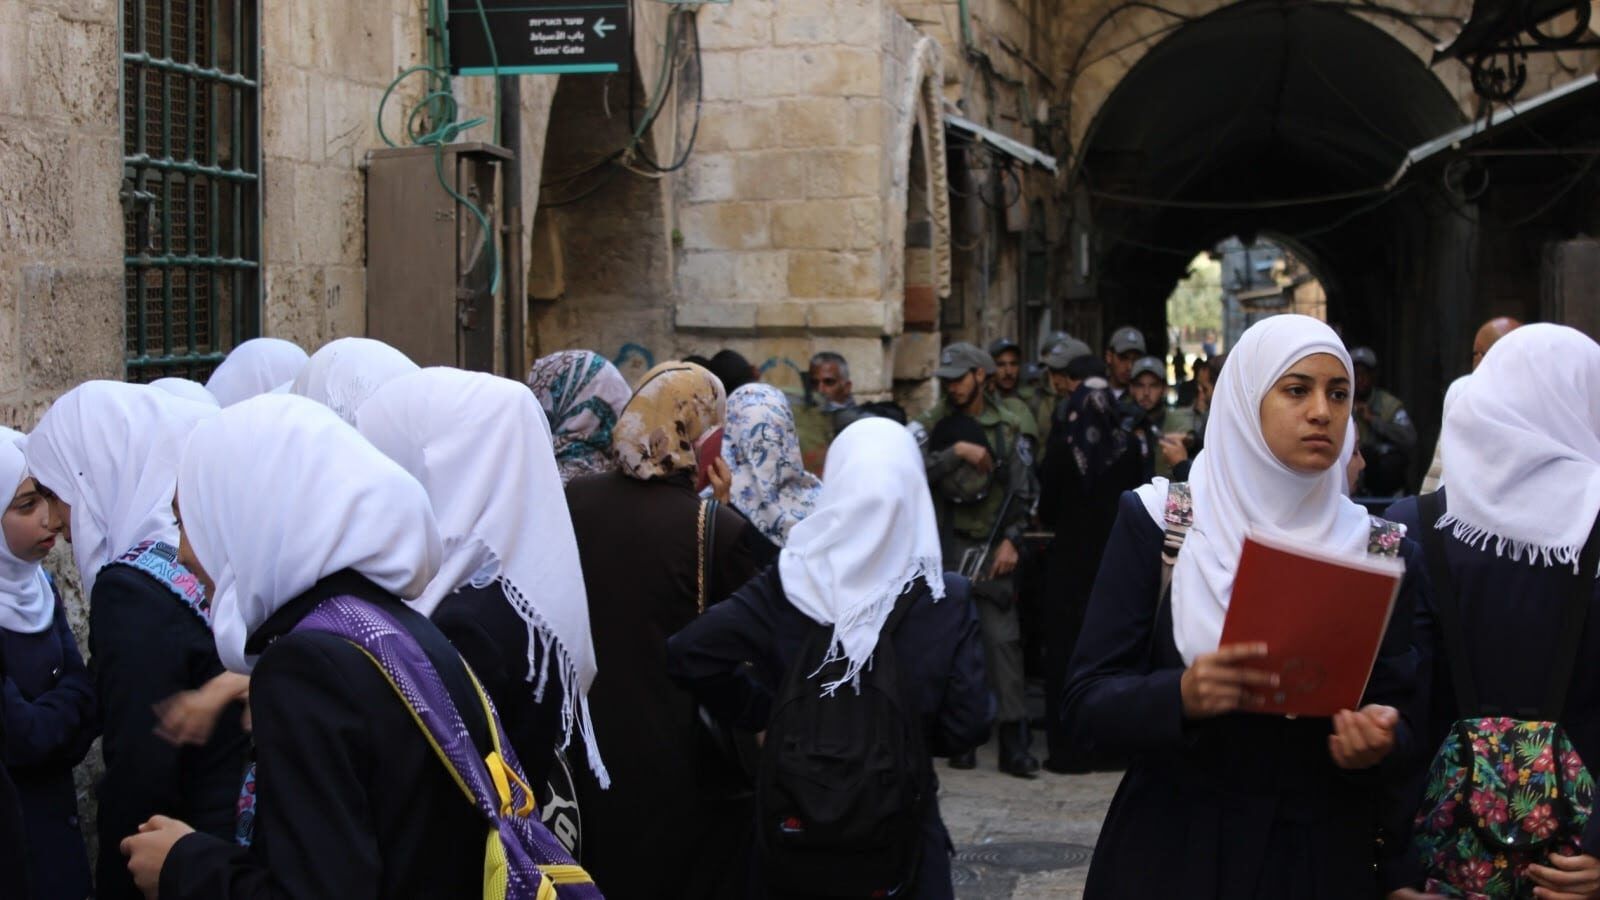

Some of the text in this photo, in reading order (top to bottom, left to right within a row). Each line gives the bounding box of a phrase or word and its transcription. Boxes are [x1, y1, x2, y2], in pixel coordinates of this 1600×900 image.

[563, 17, 585, 26] שער
[567, 30, 585, 42] باب
[562, 45, 585, 55] Gate
